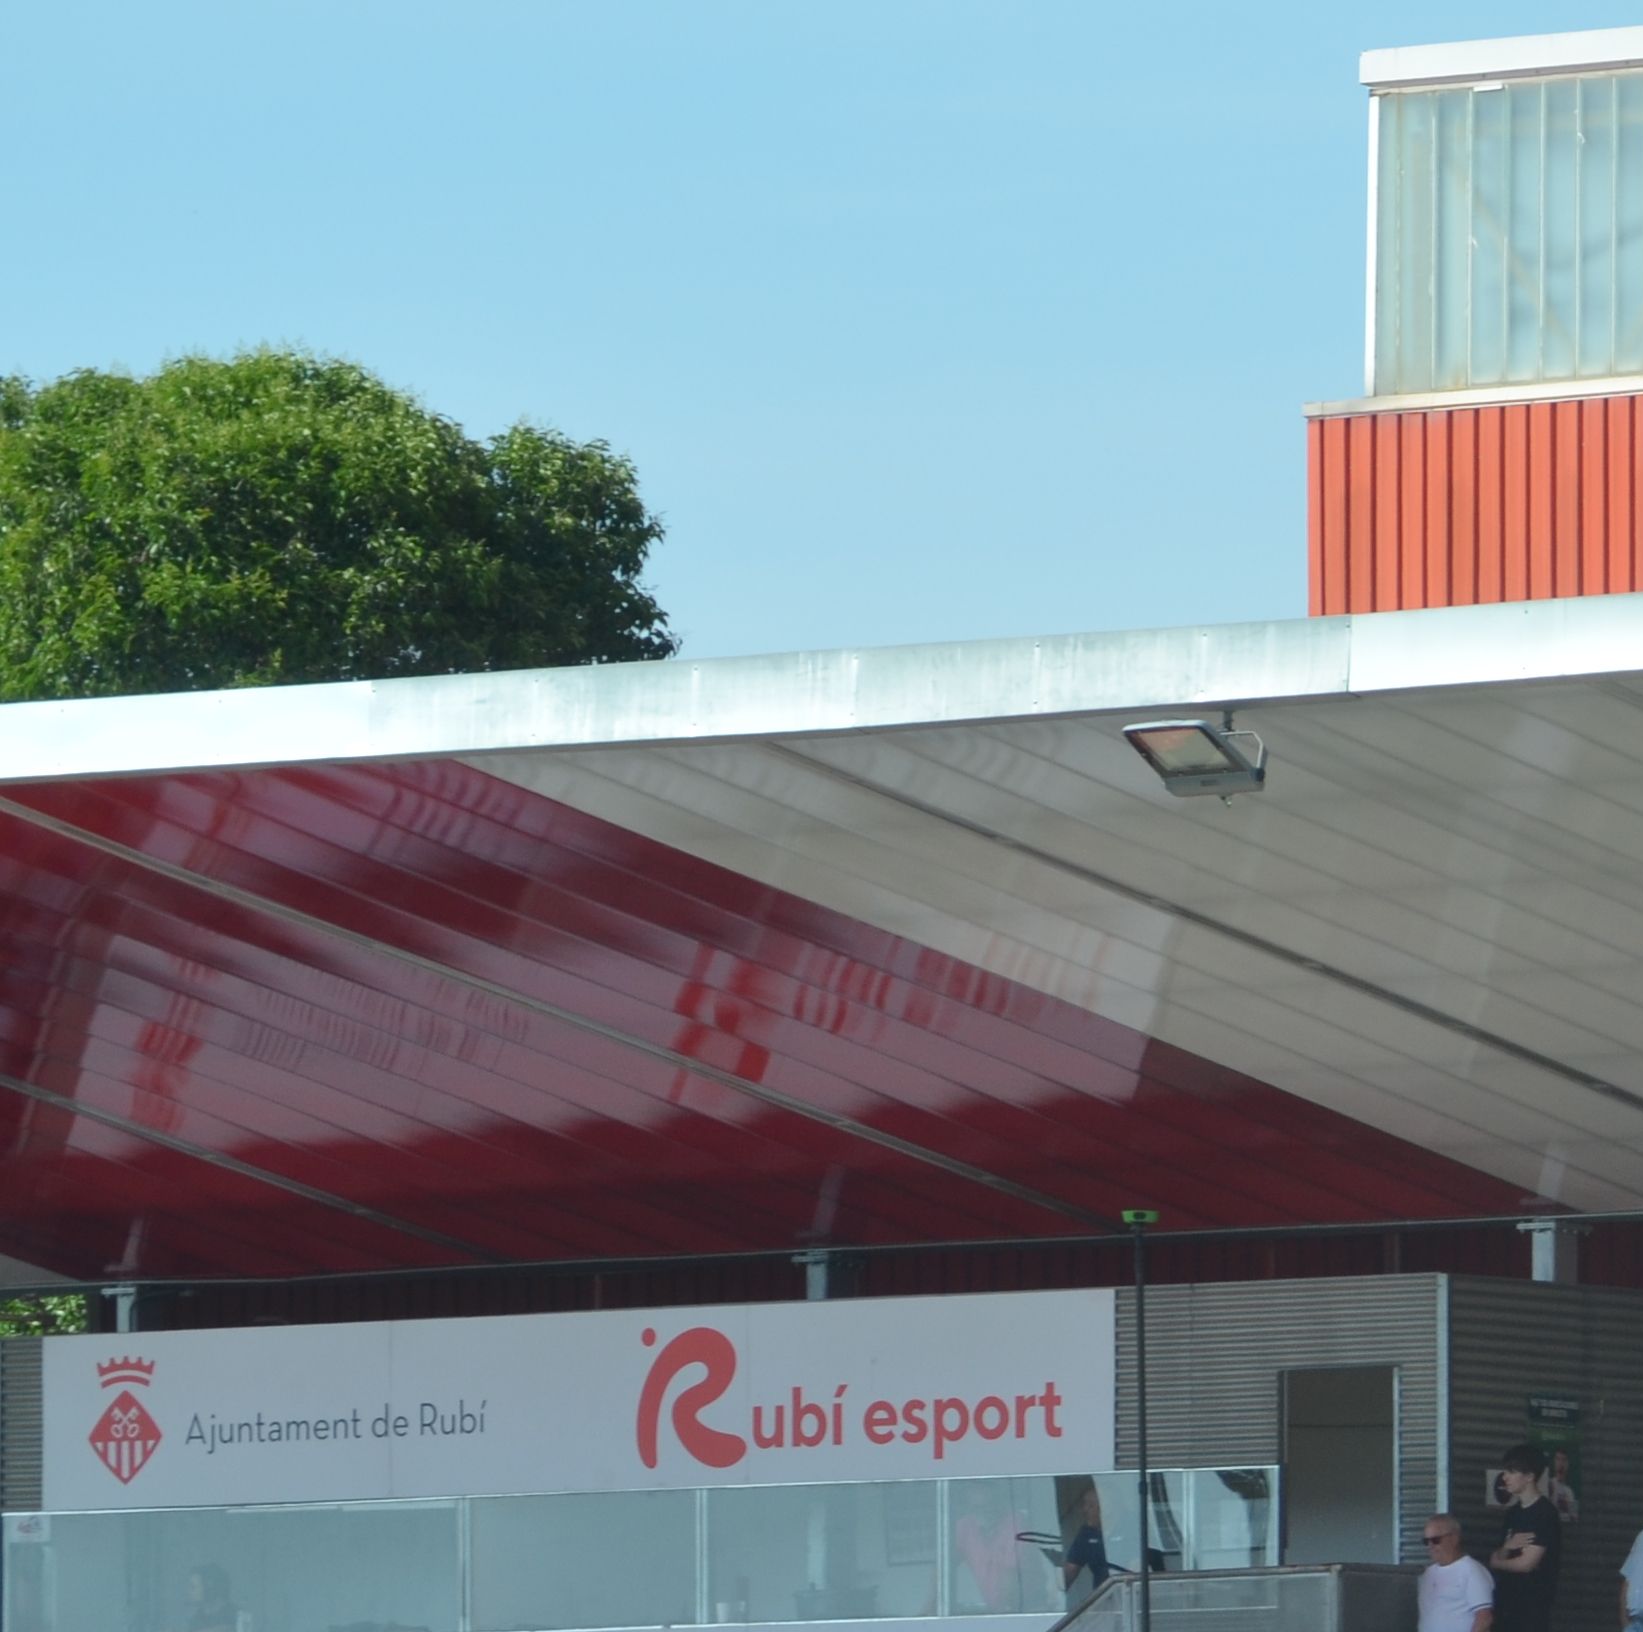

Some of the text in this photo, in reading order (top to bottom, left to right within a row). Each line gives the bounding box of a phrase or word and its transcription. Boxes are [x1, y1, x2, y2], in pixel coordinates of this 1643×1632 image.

[185, 1399, 488, 1455] Ajuntament de Rubí
[636, 1326, 1063, 1469] Rubí esport
